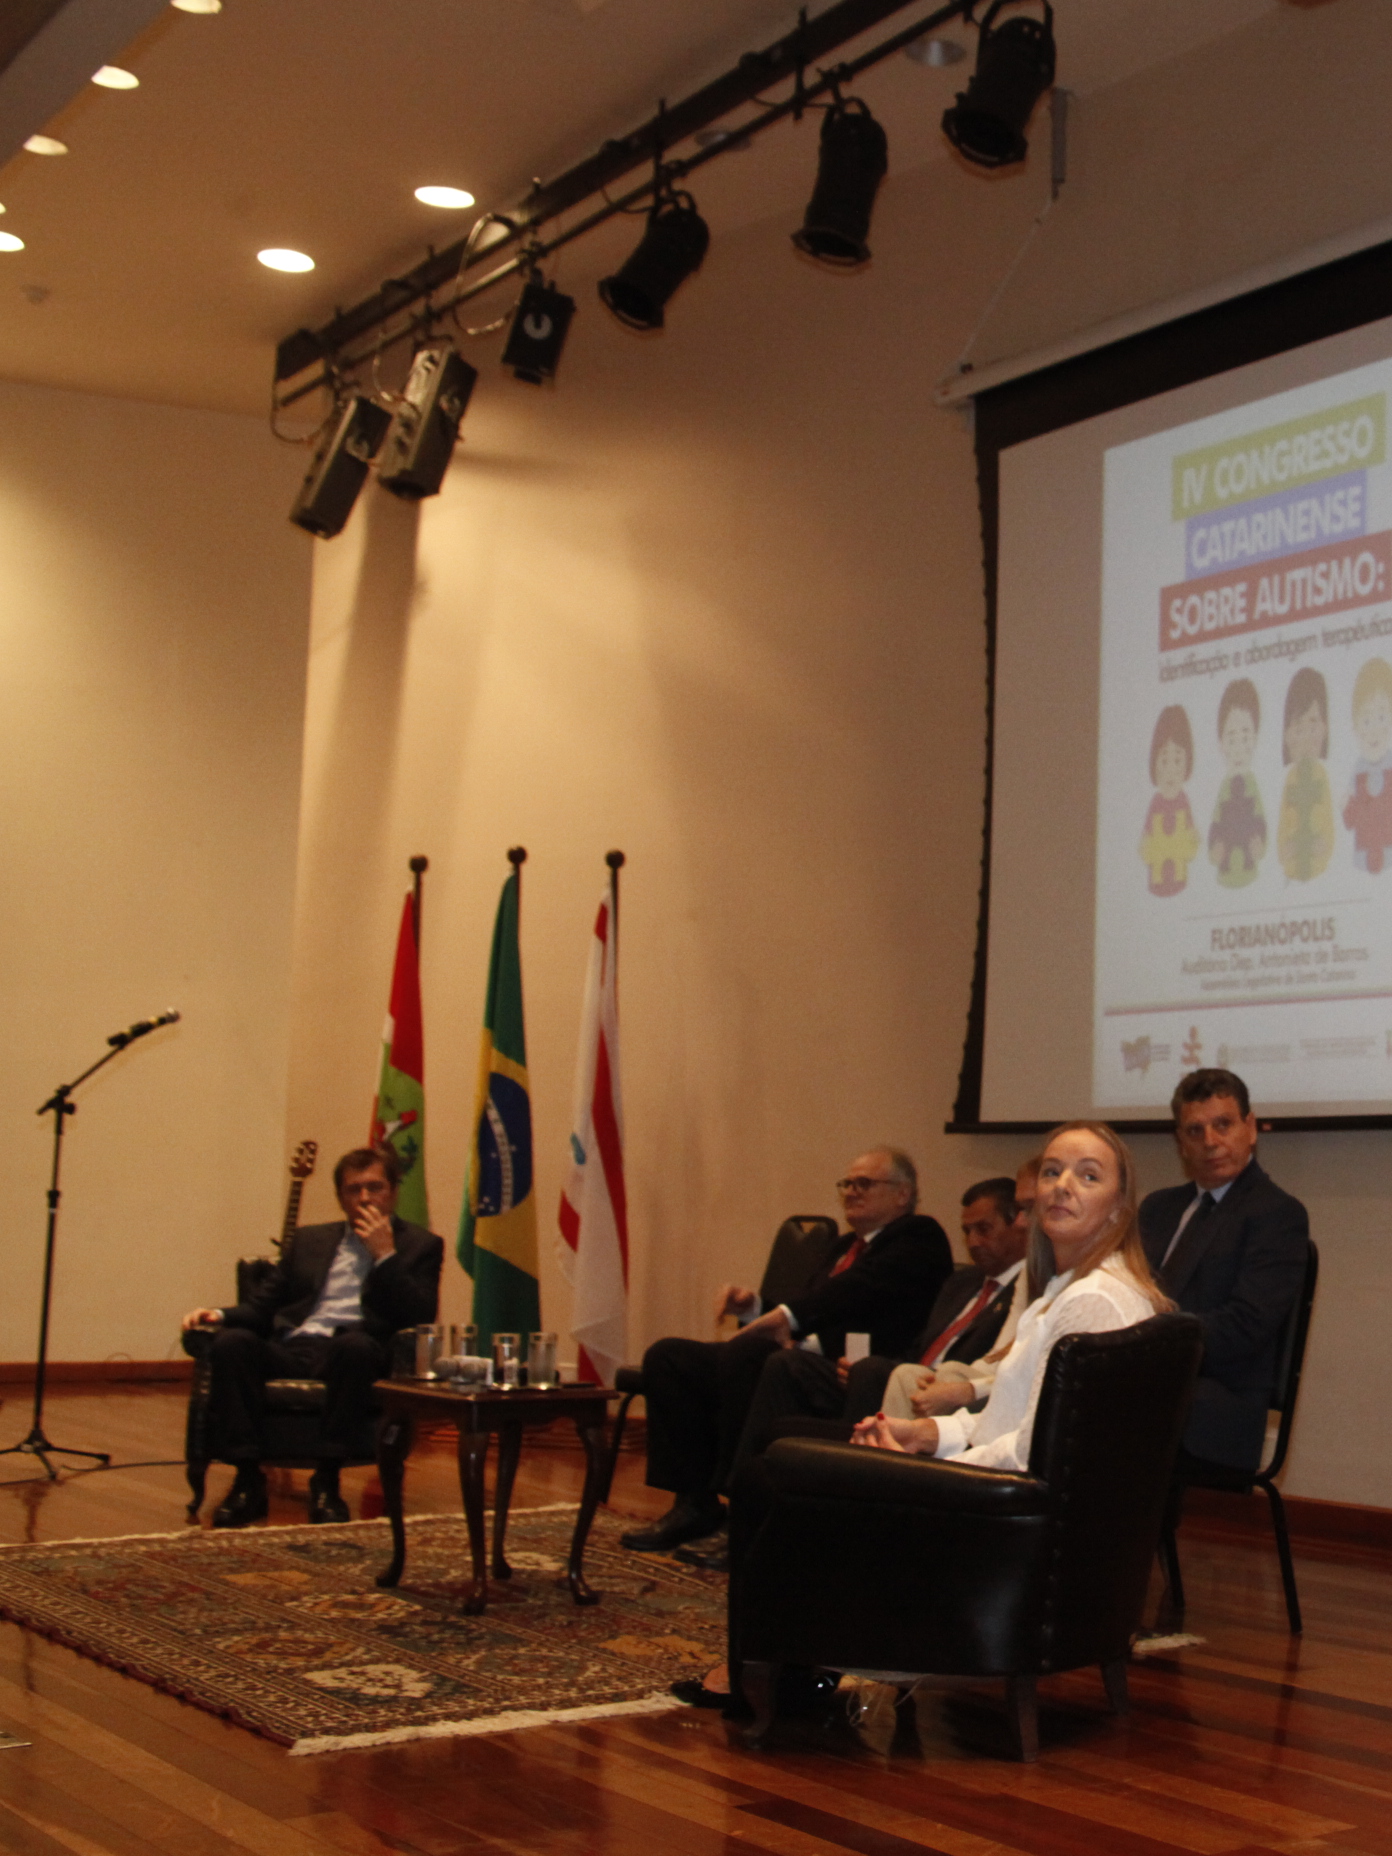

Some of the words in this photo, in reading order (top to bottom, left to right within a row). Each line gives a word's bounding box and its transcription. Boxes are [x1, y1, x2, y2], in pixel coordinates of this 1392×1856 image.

[1181, 464, 1209, 508] IV
[1212, 413, 1376, 500] CONGRESSO
[1190, 485, 1363, 590] CATARINENSE
[1168, 580, 1248, 640] SOBRE
[1253, 550, 1386, 620] AUTISMO:
